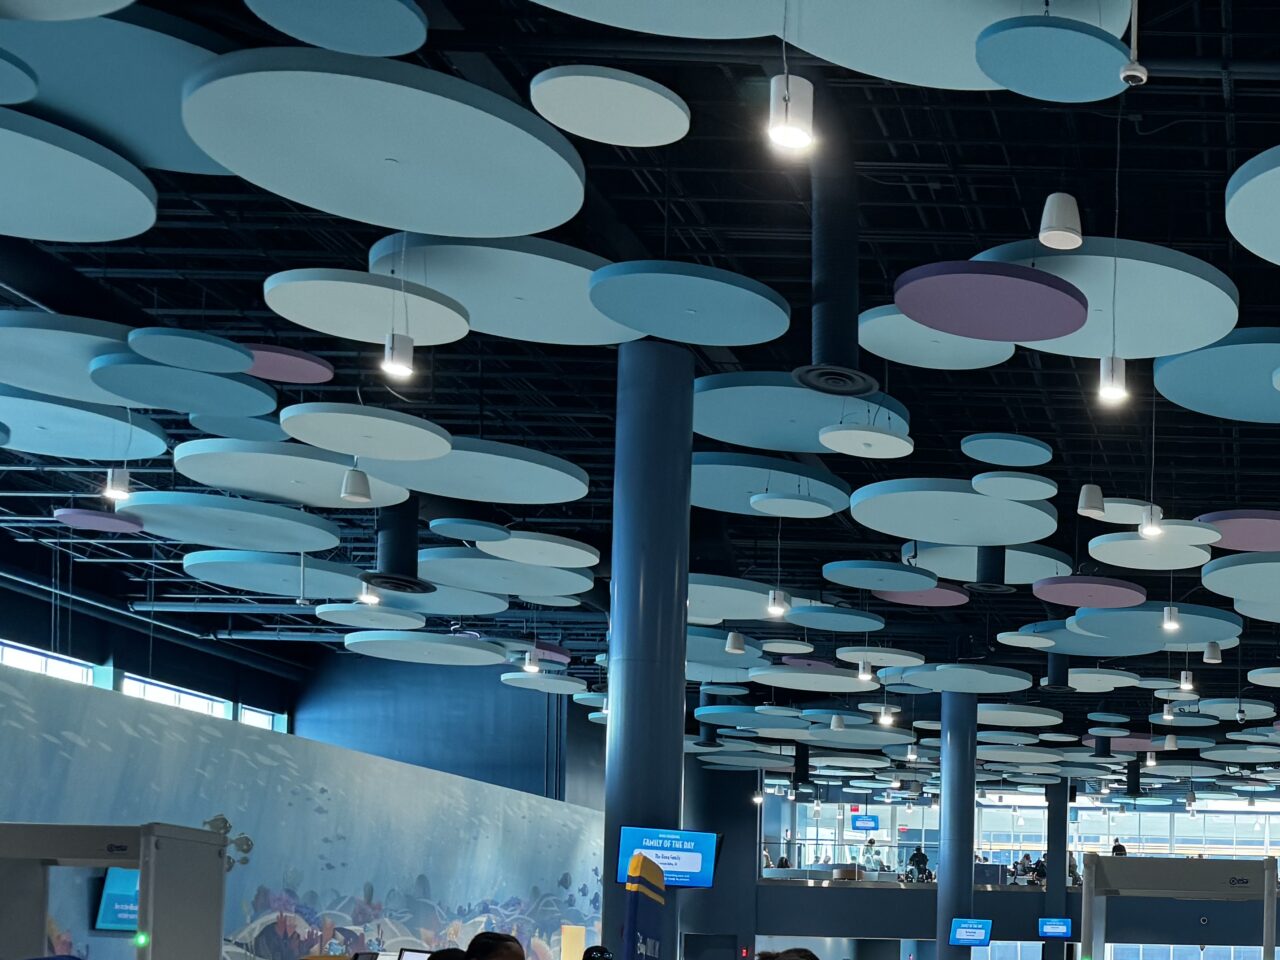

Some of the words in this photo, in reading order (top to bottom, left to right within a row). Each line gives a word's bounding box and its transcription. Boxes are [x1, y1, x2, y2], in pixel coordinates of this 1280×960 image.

[642, 838, 663, 848] FAMILY
[663, 839, 672, 848] OF
[672, 840, 683, 849] THE
[684, 841, 695, 850] DAY
